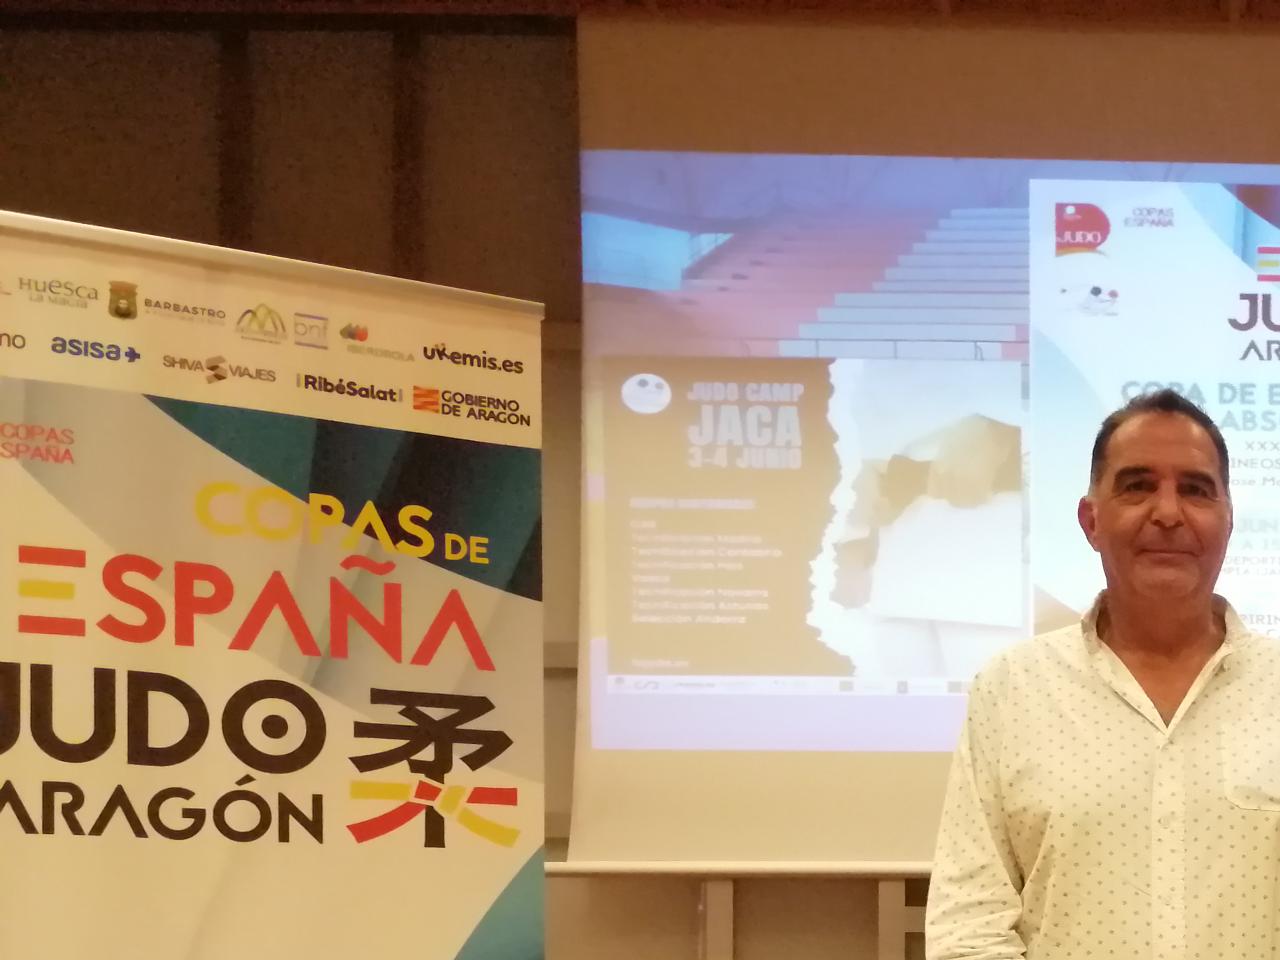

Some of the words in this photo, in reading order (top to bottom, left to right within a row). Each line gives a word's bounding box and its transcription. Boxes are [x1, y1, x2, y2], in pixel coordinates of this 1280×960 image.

[144, 298, 226, 319] BARBASTRO
[230, 366, 276, 382] VIAJES
[442, 390, 520, 412] GOBIERNO
[1218, 383, 1254, 406] DE
[442, 404, 460, 416] DE
[688, 404, 802, 447] JACA
[688, 447, 728, 467] 3-4
[194, 481, 434, 559] COPAS
[444, 533, 489, 564] DE
[18, 544, 496, 671] ESPAÑA
[0, 774, 323, 844] ARAGÓN
